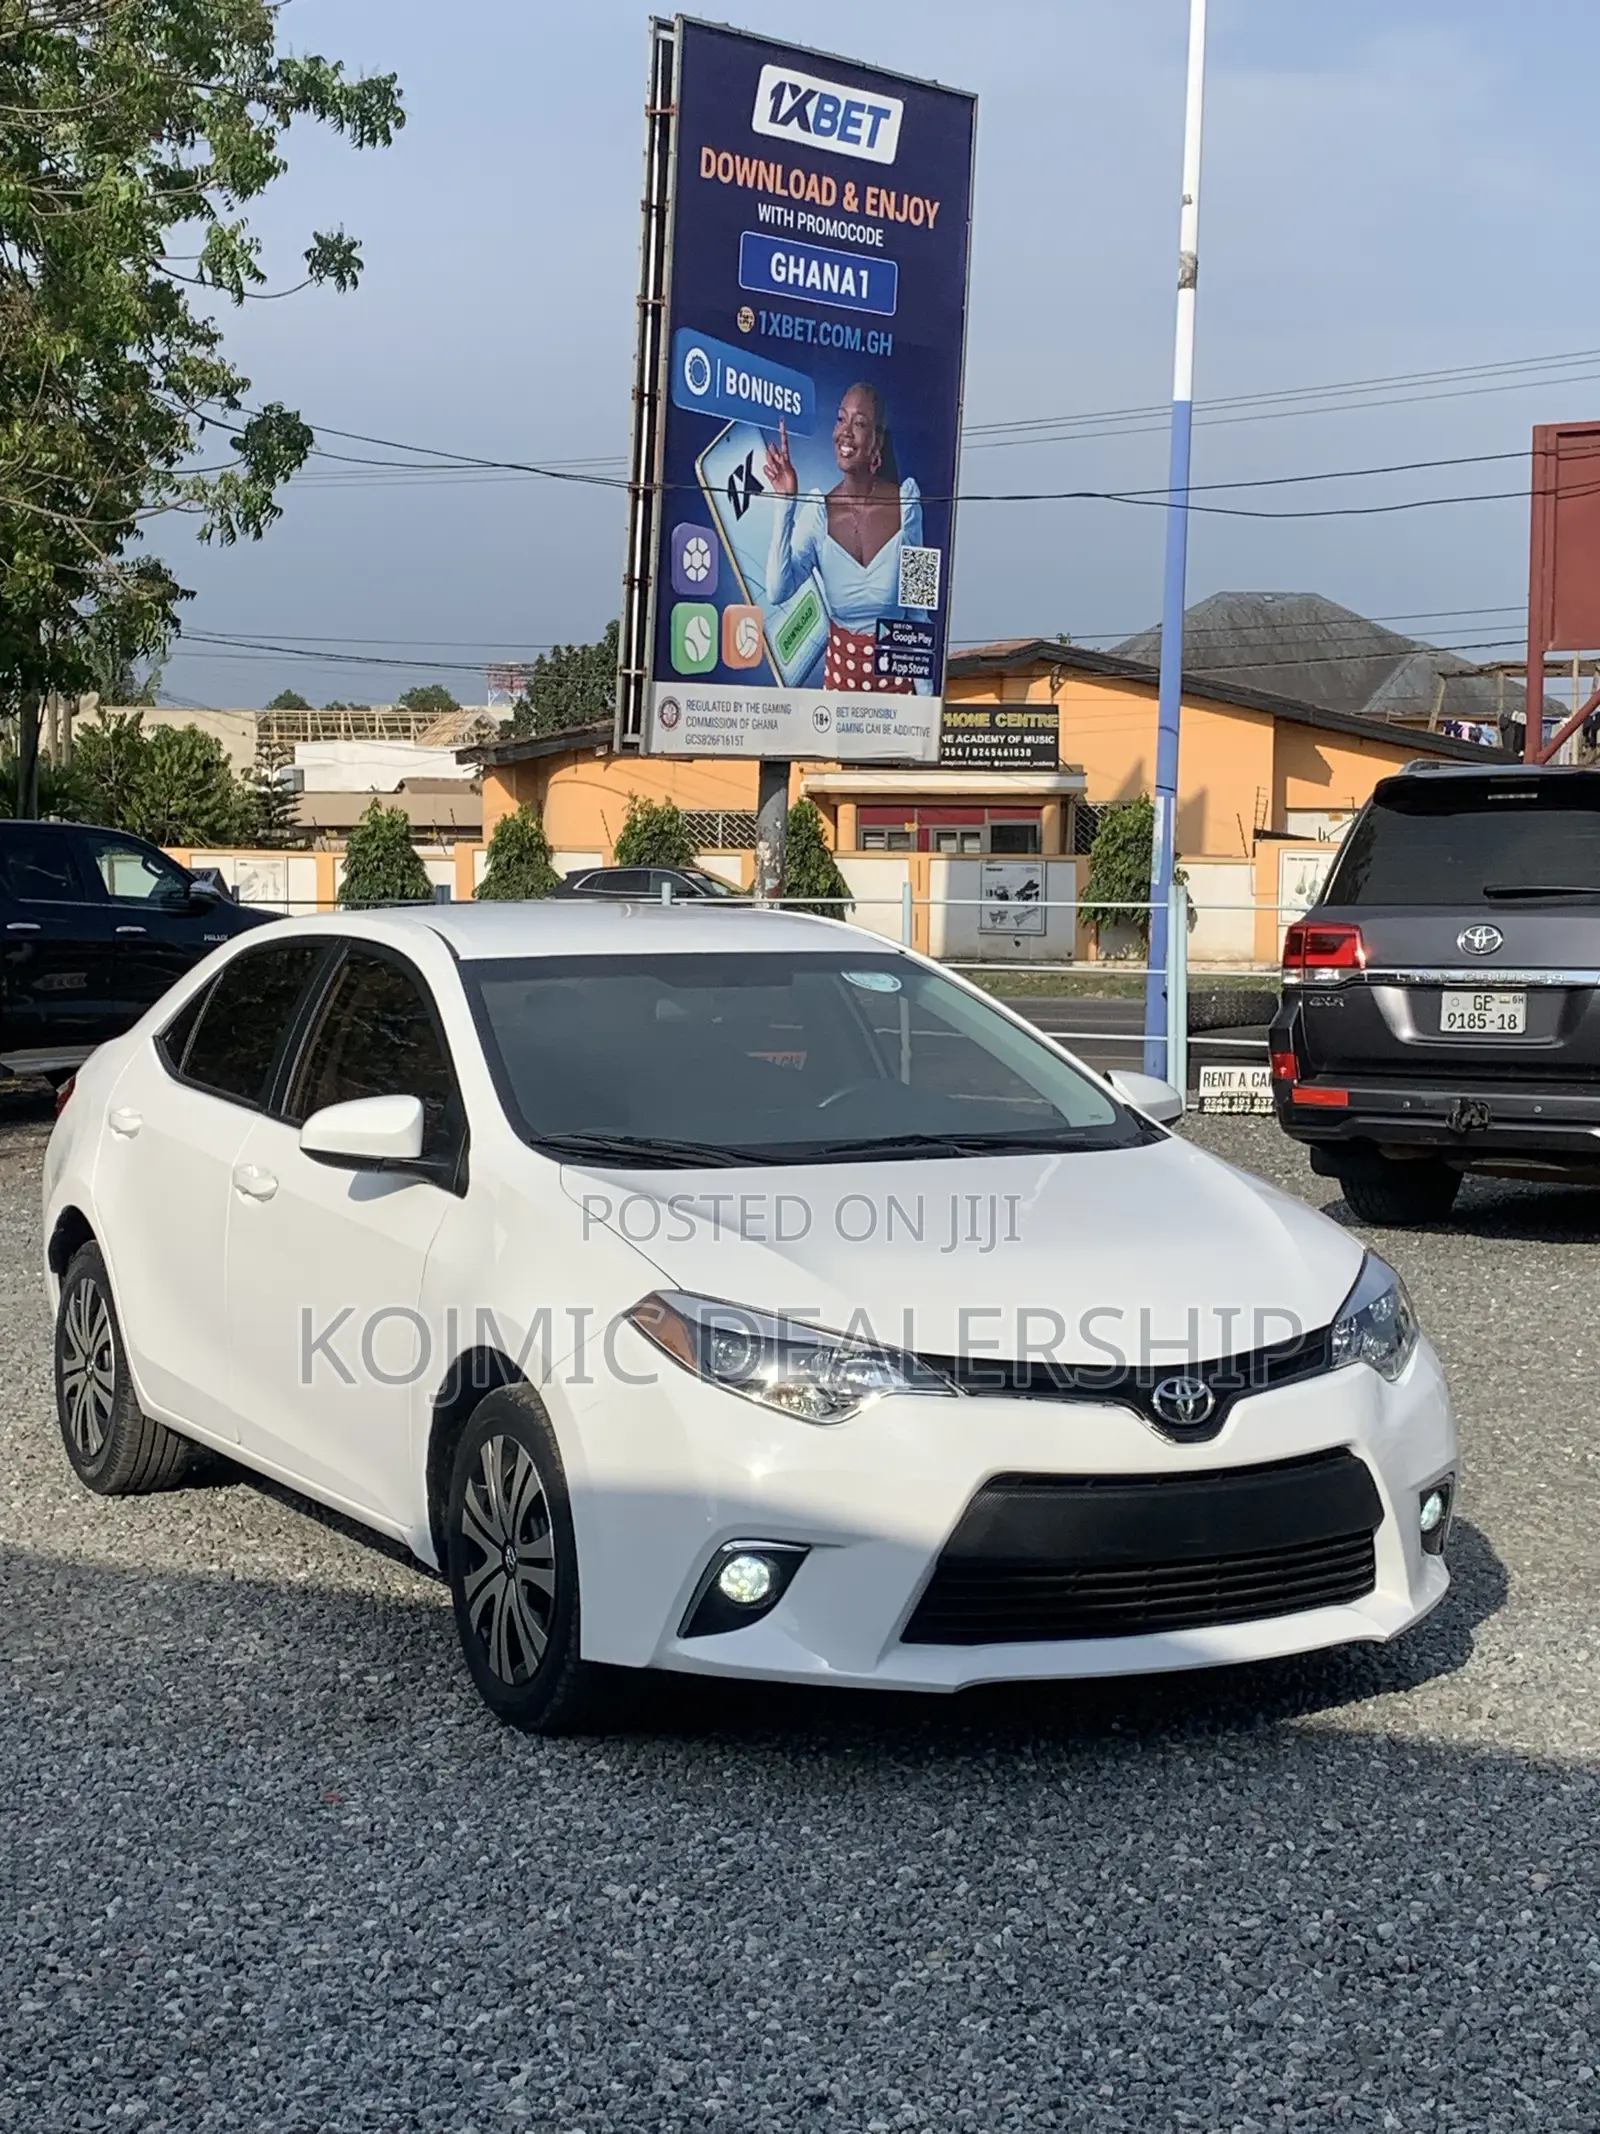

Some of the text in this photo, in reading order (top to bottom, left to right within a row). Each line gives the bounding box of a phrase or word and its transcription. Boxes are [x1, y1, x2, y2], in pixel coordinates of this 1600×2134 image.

[769, 80, 891, 149] 1XBET
[701, 147, 940, 229] DOWNLOAD & ENJOY
[757, 203, 884, 247] WITH PROMOCODE
[770, 252, 869, 299] GHANA1
[758, 310, 893, 357] 1XBET.COM.GH
[725, 366, 801, 415] BONUSES
[892, 630, 932, 647] Google Play
[892, 661, 930, 676] App Store
[686, 699, 792, 715] REGULATED BY THE GAMING
[836, 706, 898, 720] BET RESPONSIBLY
[685, 716, 779, 730] COMMISSION OF GHANA
[814, 713, 829, 726] 18+
[995, 713, 1059, 728] CENTRE
[836, 722, 931, 738] GAMING CAN BE ADDICTIVE
[955, 735, 1005, 744] ACADEMY
[1007, 735, 1021, 744] OF
[1023, 735, 1056, 744] MUSIC
[1395, 969, 1566, 985] LAND CRUISER
[1473, 994, 1493, 1012] GE
[1447, 1012, 1518, 1031] 9185-18
[1203, 1072, 1235, 1087] RENT
[1239, 1072, 1247, 1087] A
